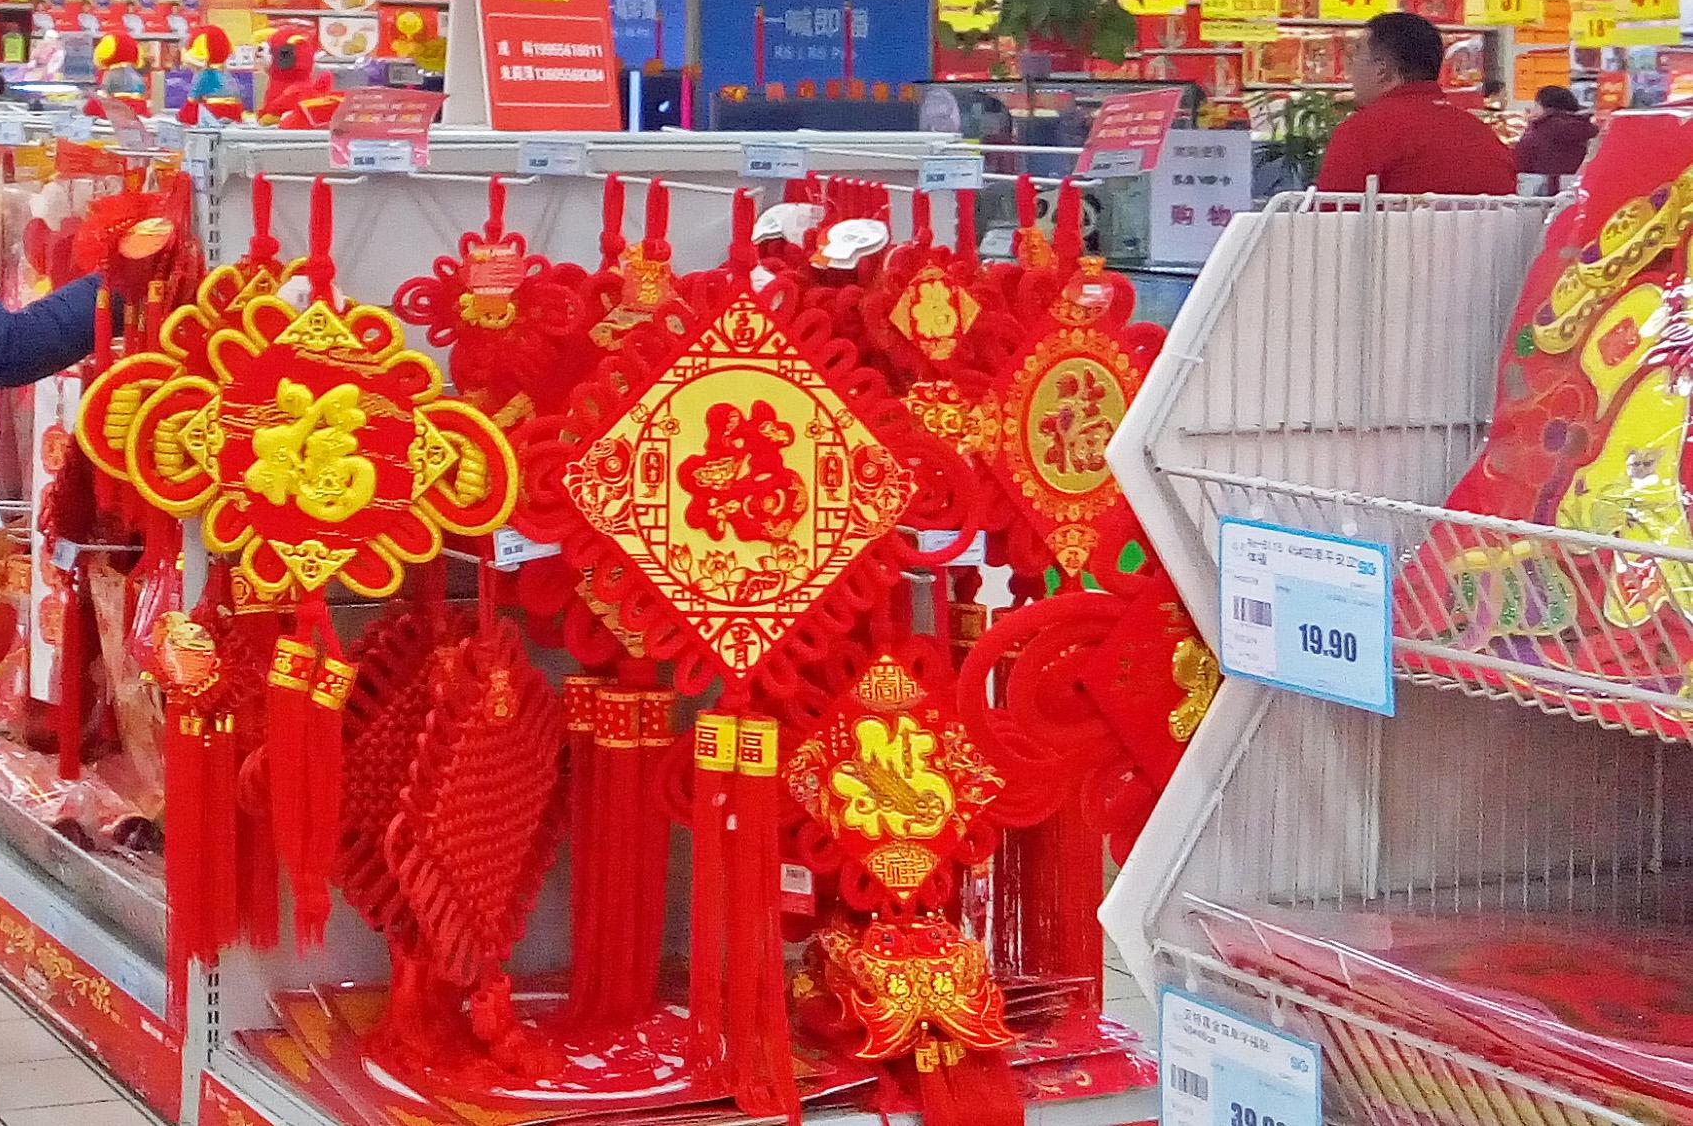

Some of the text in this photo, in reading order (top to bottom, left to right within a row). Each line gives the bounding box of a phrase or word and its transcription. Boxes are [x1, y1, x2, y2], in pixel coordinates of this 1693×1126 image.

[245, 377, 376, 522] 福
[676, 399, 808, 542] 福
[1298, 623, 1357, 663] 19.90
